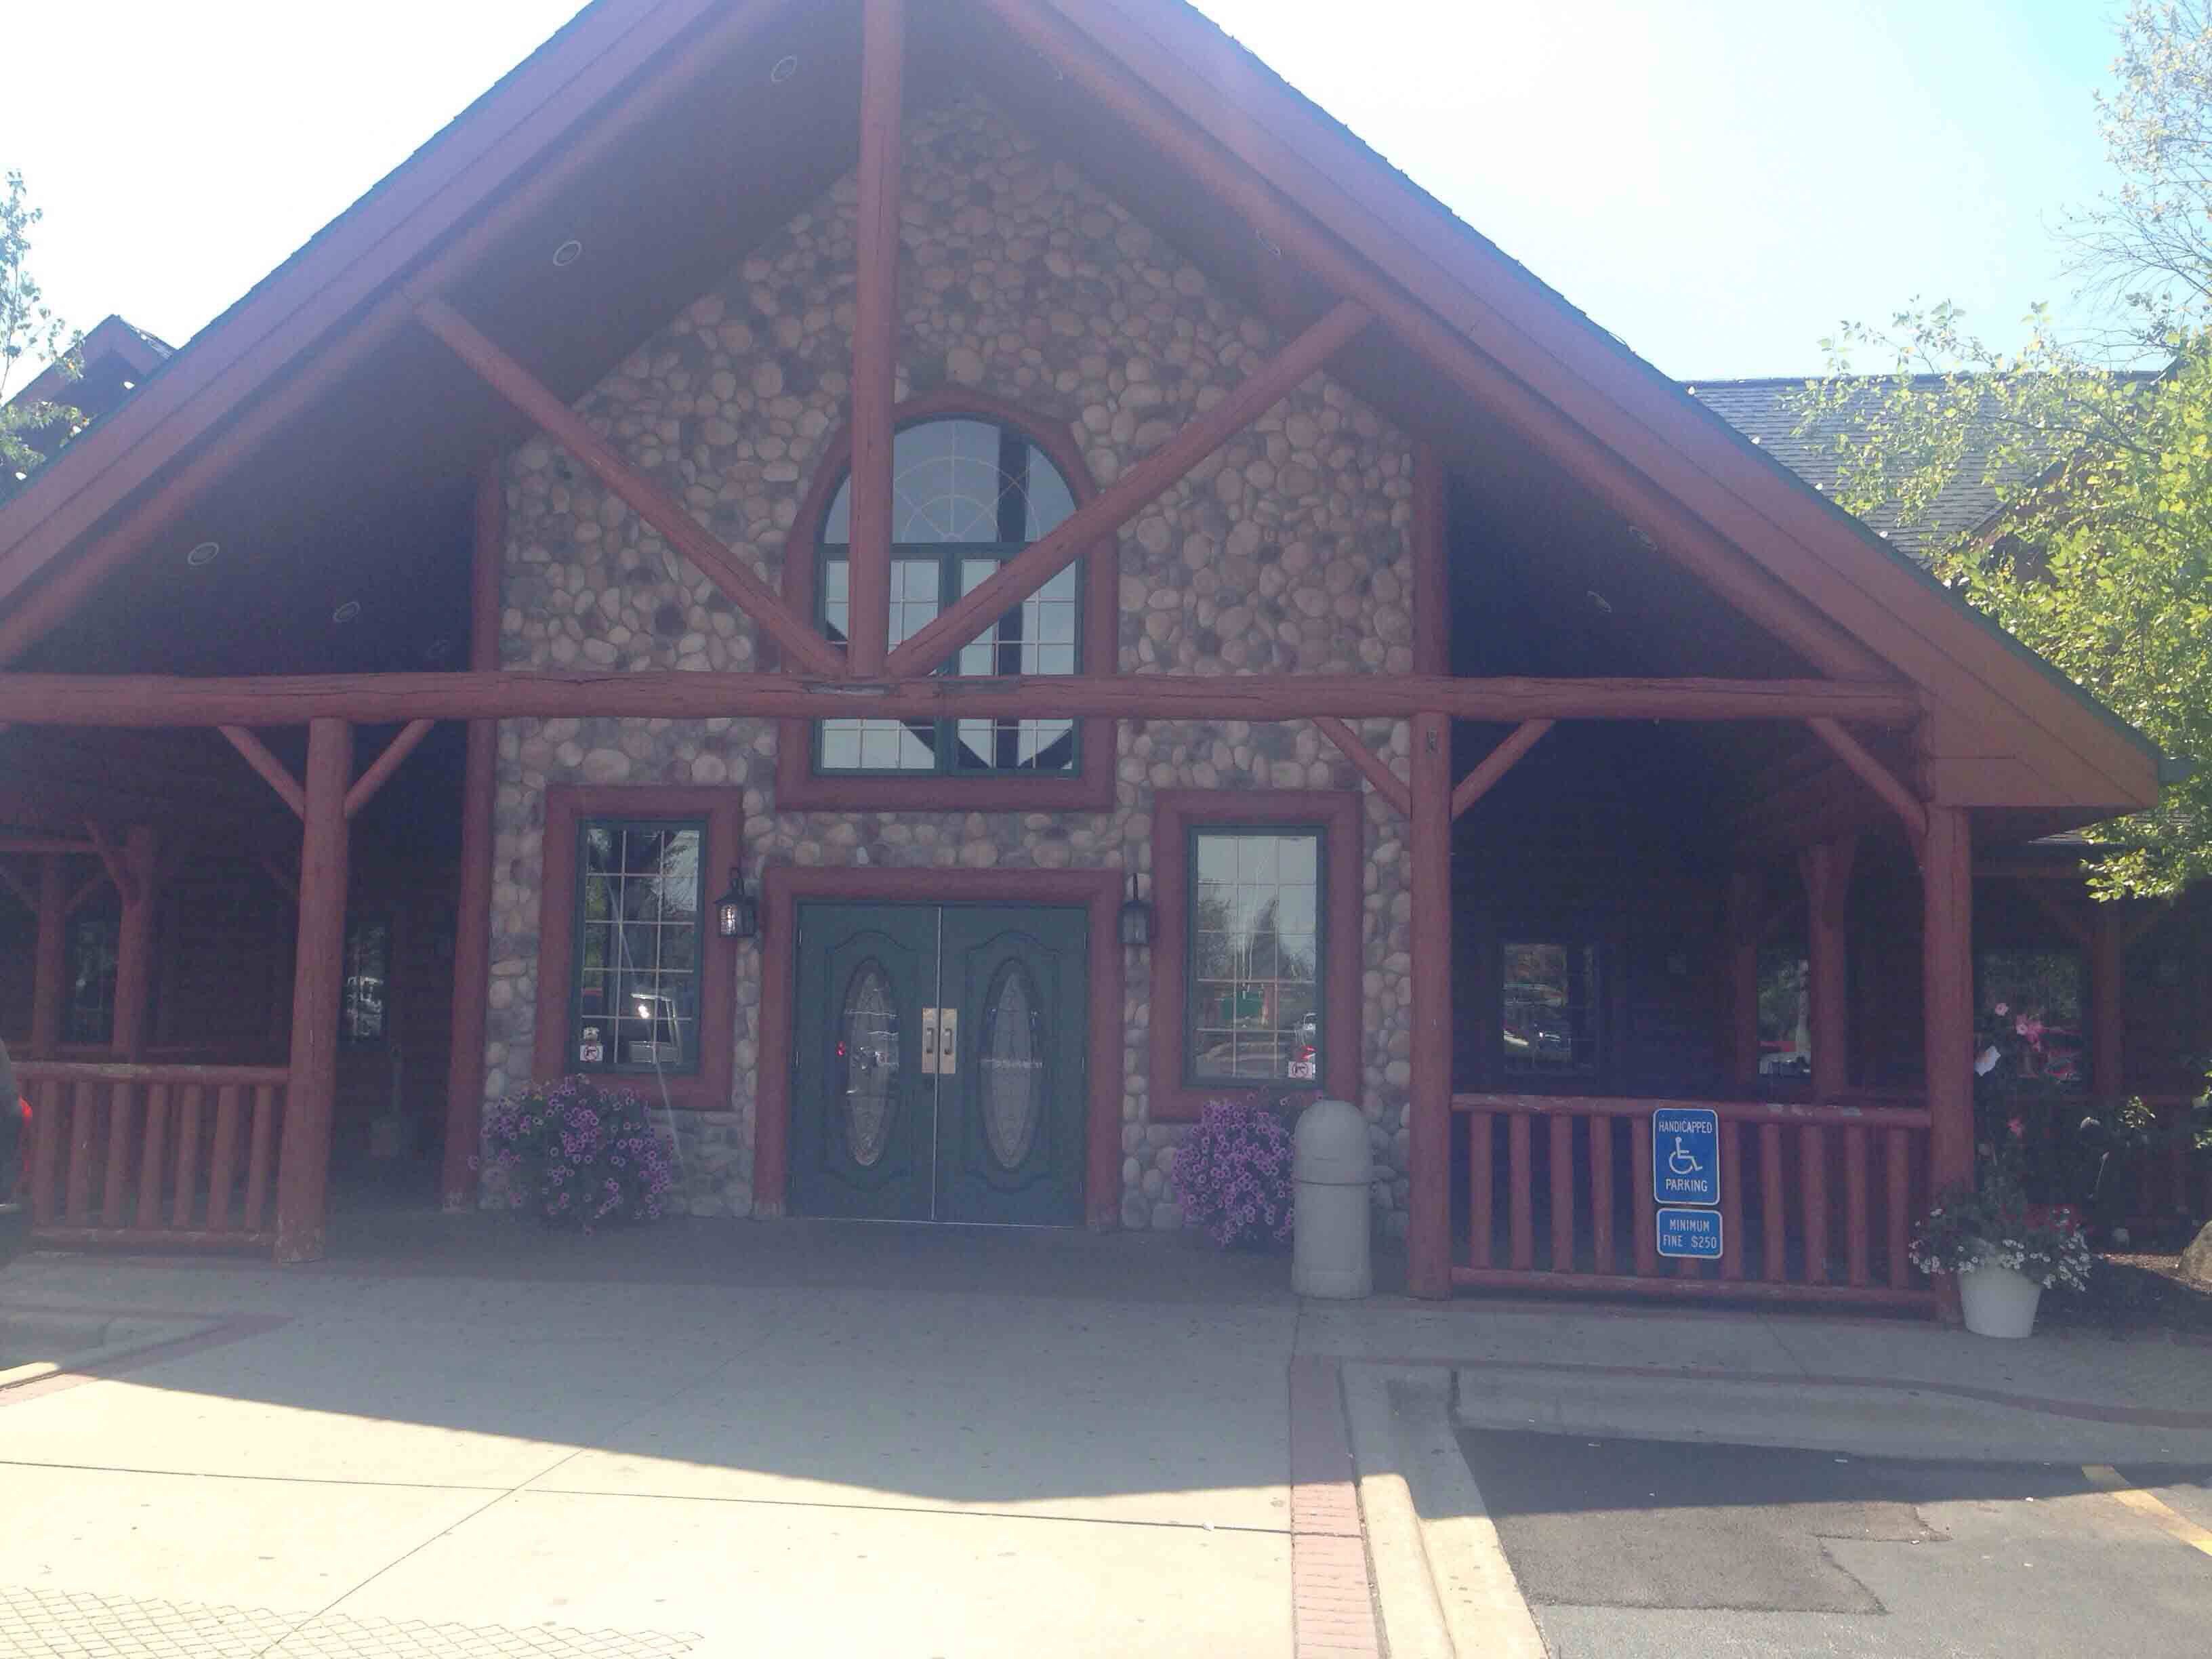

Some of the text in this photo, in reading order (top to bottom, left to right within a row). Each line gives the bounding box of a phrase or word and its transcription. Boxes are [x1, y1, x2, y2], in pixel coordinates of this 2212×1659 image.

[1659, 1121, 1713, 1134] HANDICAPPED
[1665, 1179, 1708, 1192] PARKING
[1669, 1219, 1709, 1232] MINIMUM
[1663, 1235, 1717, 1249] FINE $250
